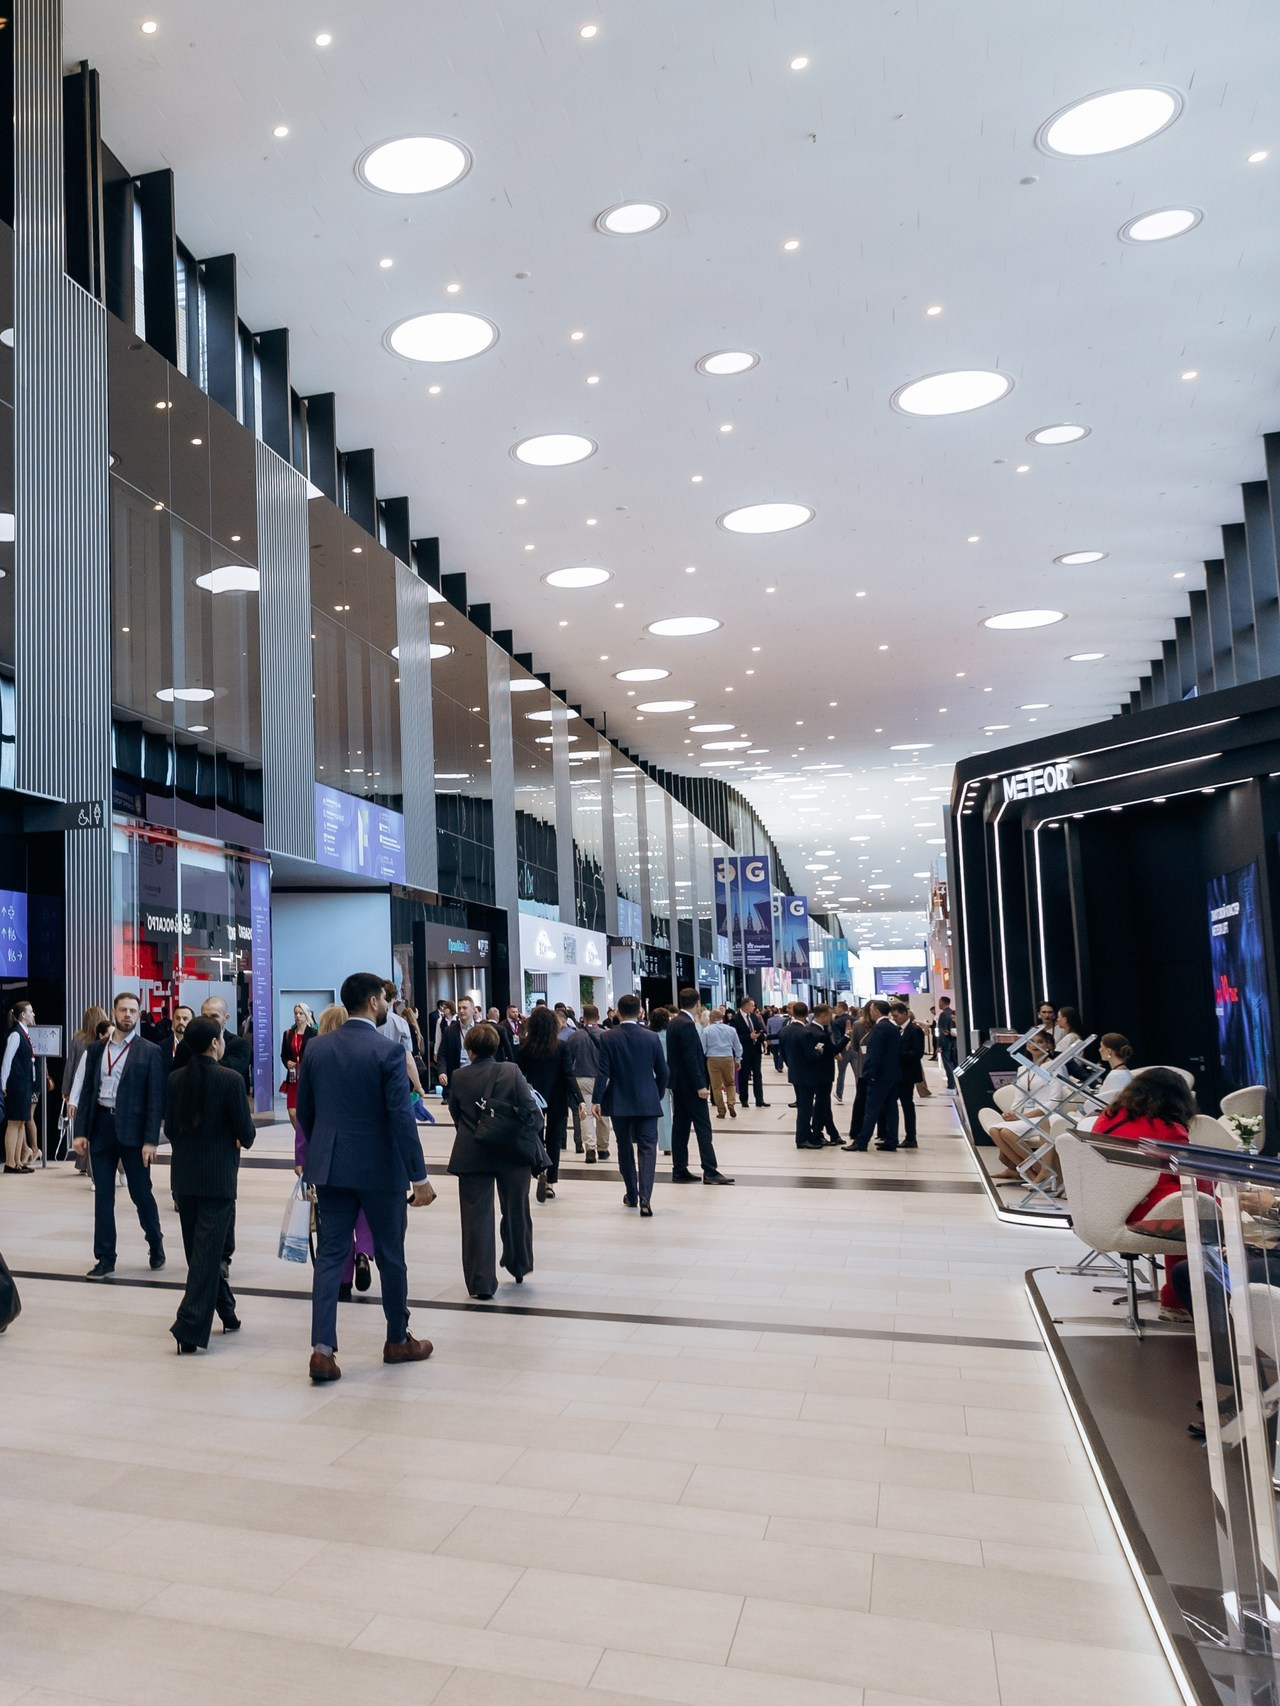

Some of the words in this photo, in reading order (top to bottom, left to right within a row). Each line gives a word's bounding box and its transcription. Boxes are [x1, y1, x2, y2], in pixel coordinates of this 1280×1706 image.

[1002, 763, 1073, 802] METEOR
[746, 862, 765, 882] G
[790, 900, 804, 916] G
